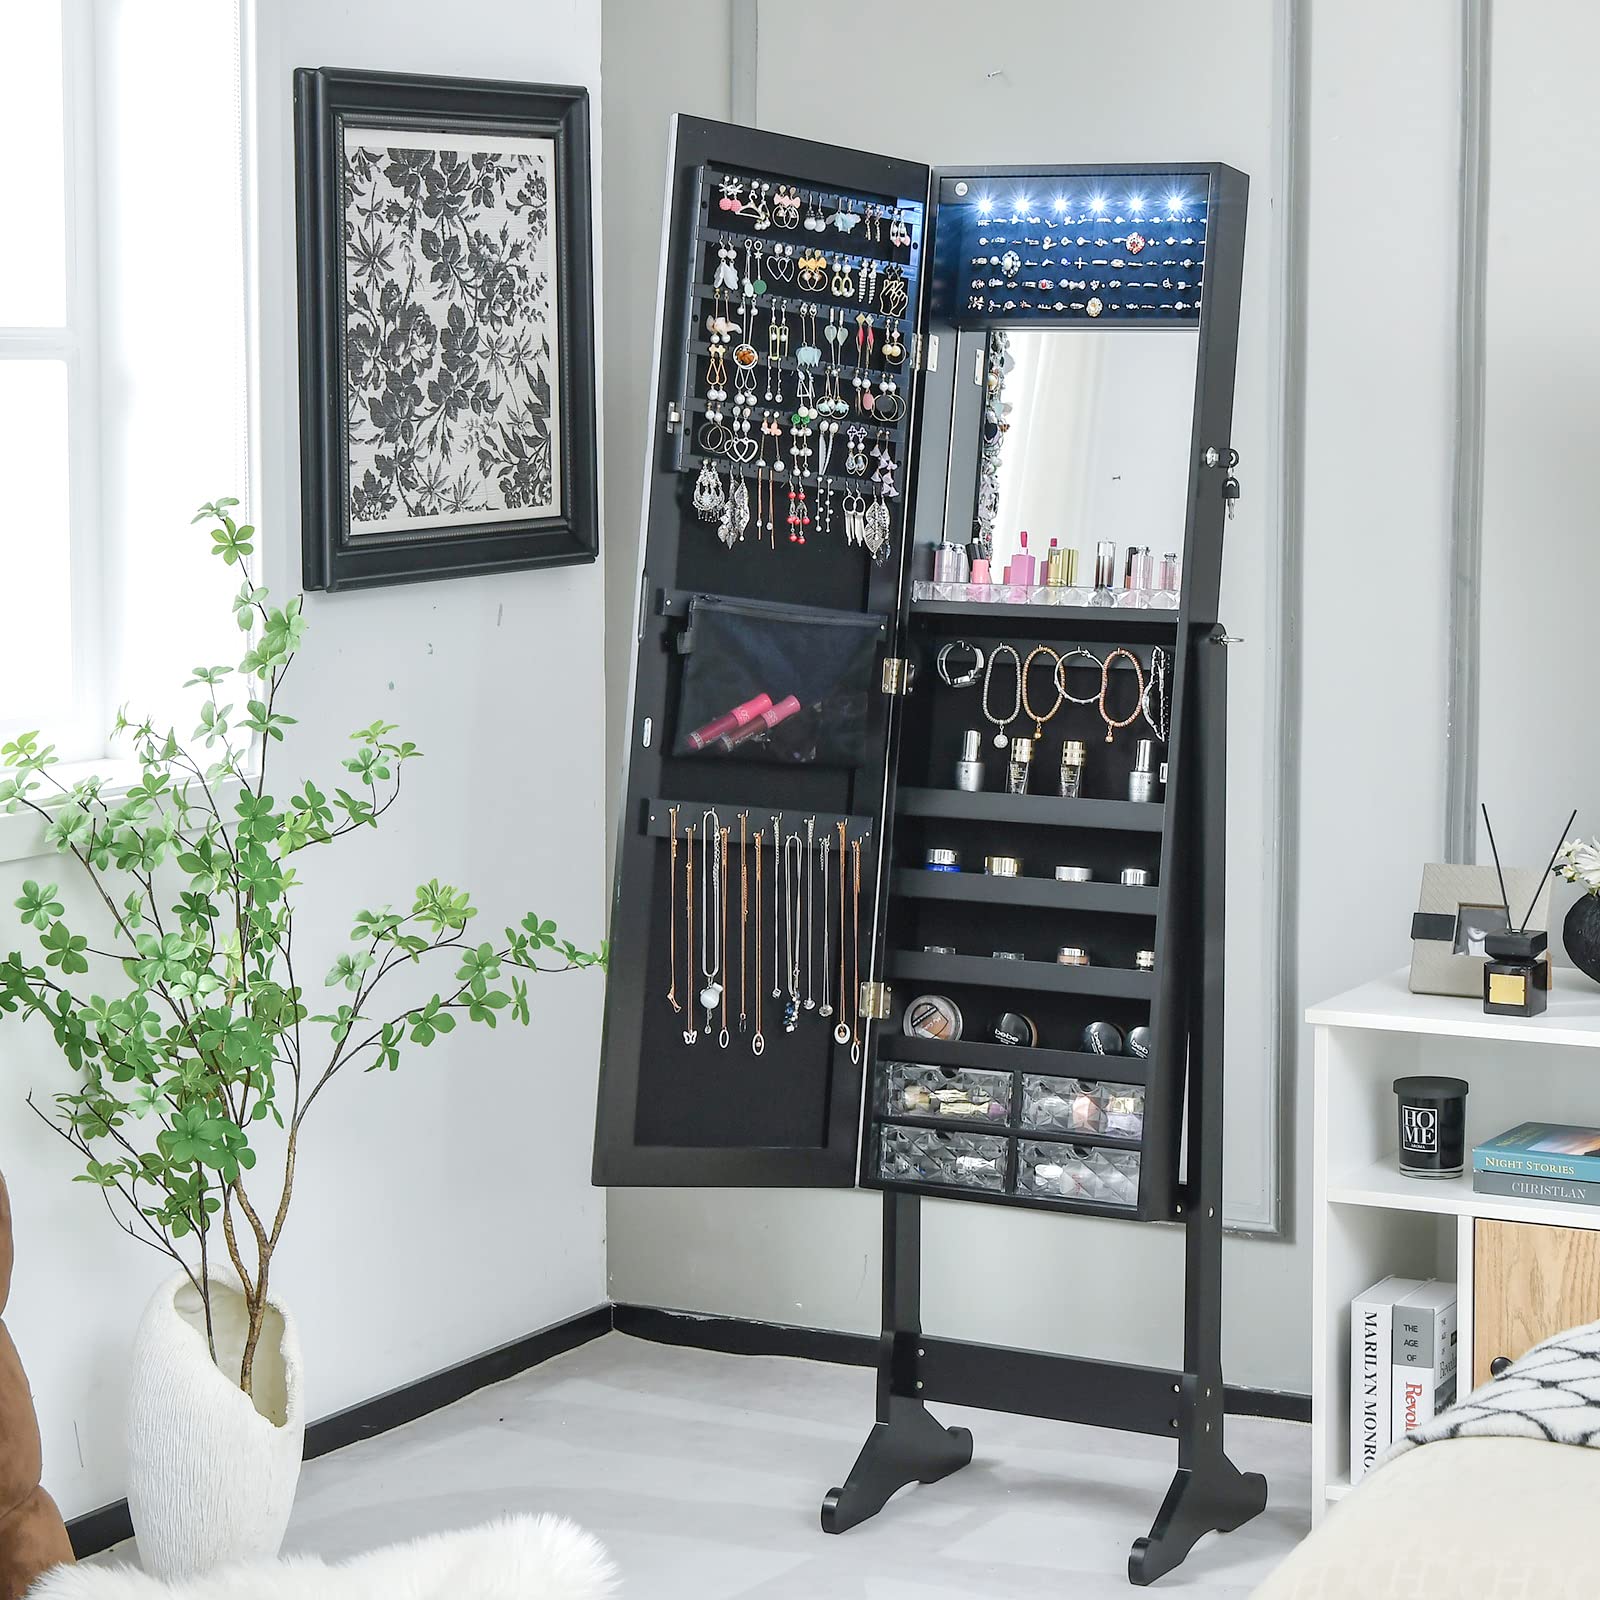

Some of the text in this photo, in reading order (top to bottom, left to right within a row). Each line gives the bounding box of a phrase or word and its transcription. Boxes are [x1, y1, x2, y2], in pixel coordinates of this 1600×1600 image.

[1131, 1039, 1149, 1055] beb
[1403, 1324, 1419, 1333] THE
[1403, 1339, 1419, 1348] AGE
[1406, 1354, 1417, 1362] OF
[1363, 1311, 1378, 1473] MARILYN MONRO
